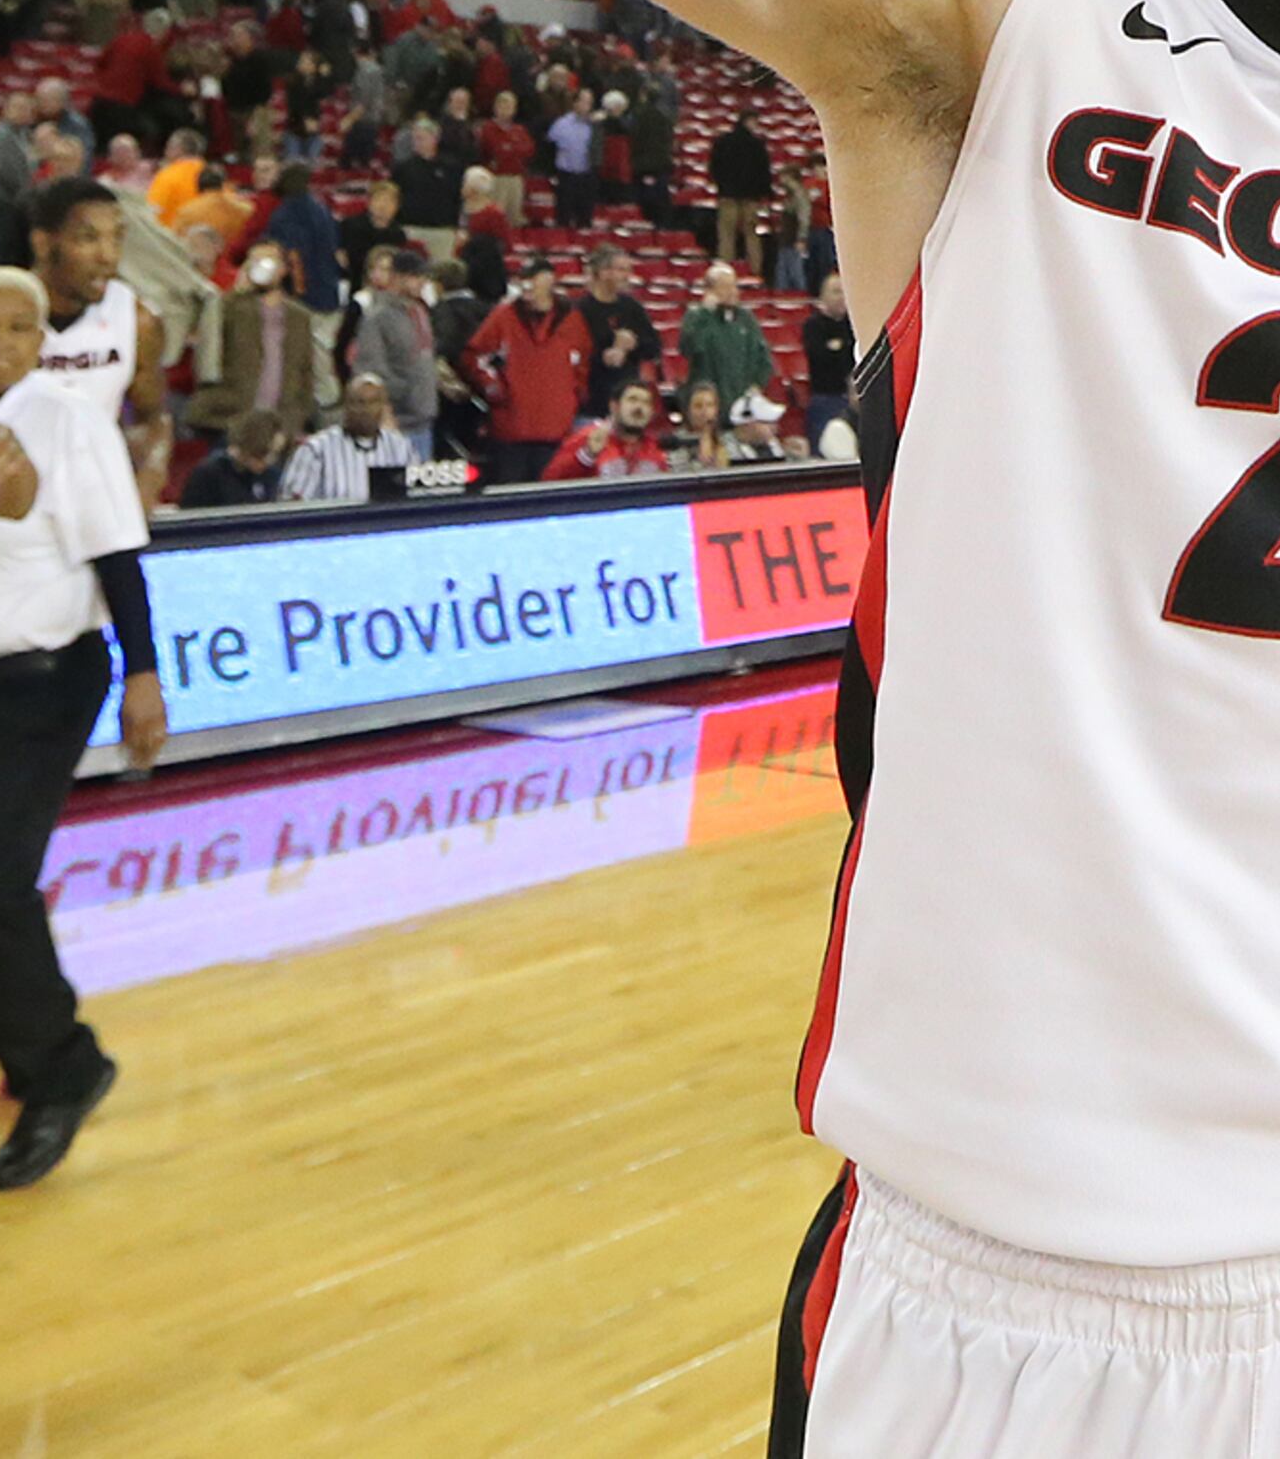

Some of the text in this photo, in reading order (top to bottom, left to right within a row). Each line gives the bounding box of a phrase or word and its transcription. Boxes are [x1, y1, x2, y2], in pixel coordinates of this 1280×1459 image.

[172, 622, 250, 689] re
[279, 572, 576, 674] Provider
[598, 559, 678, 624] for
[707, 520, 852, 611] THE
